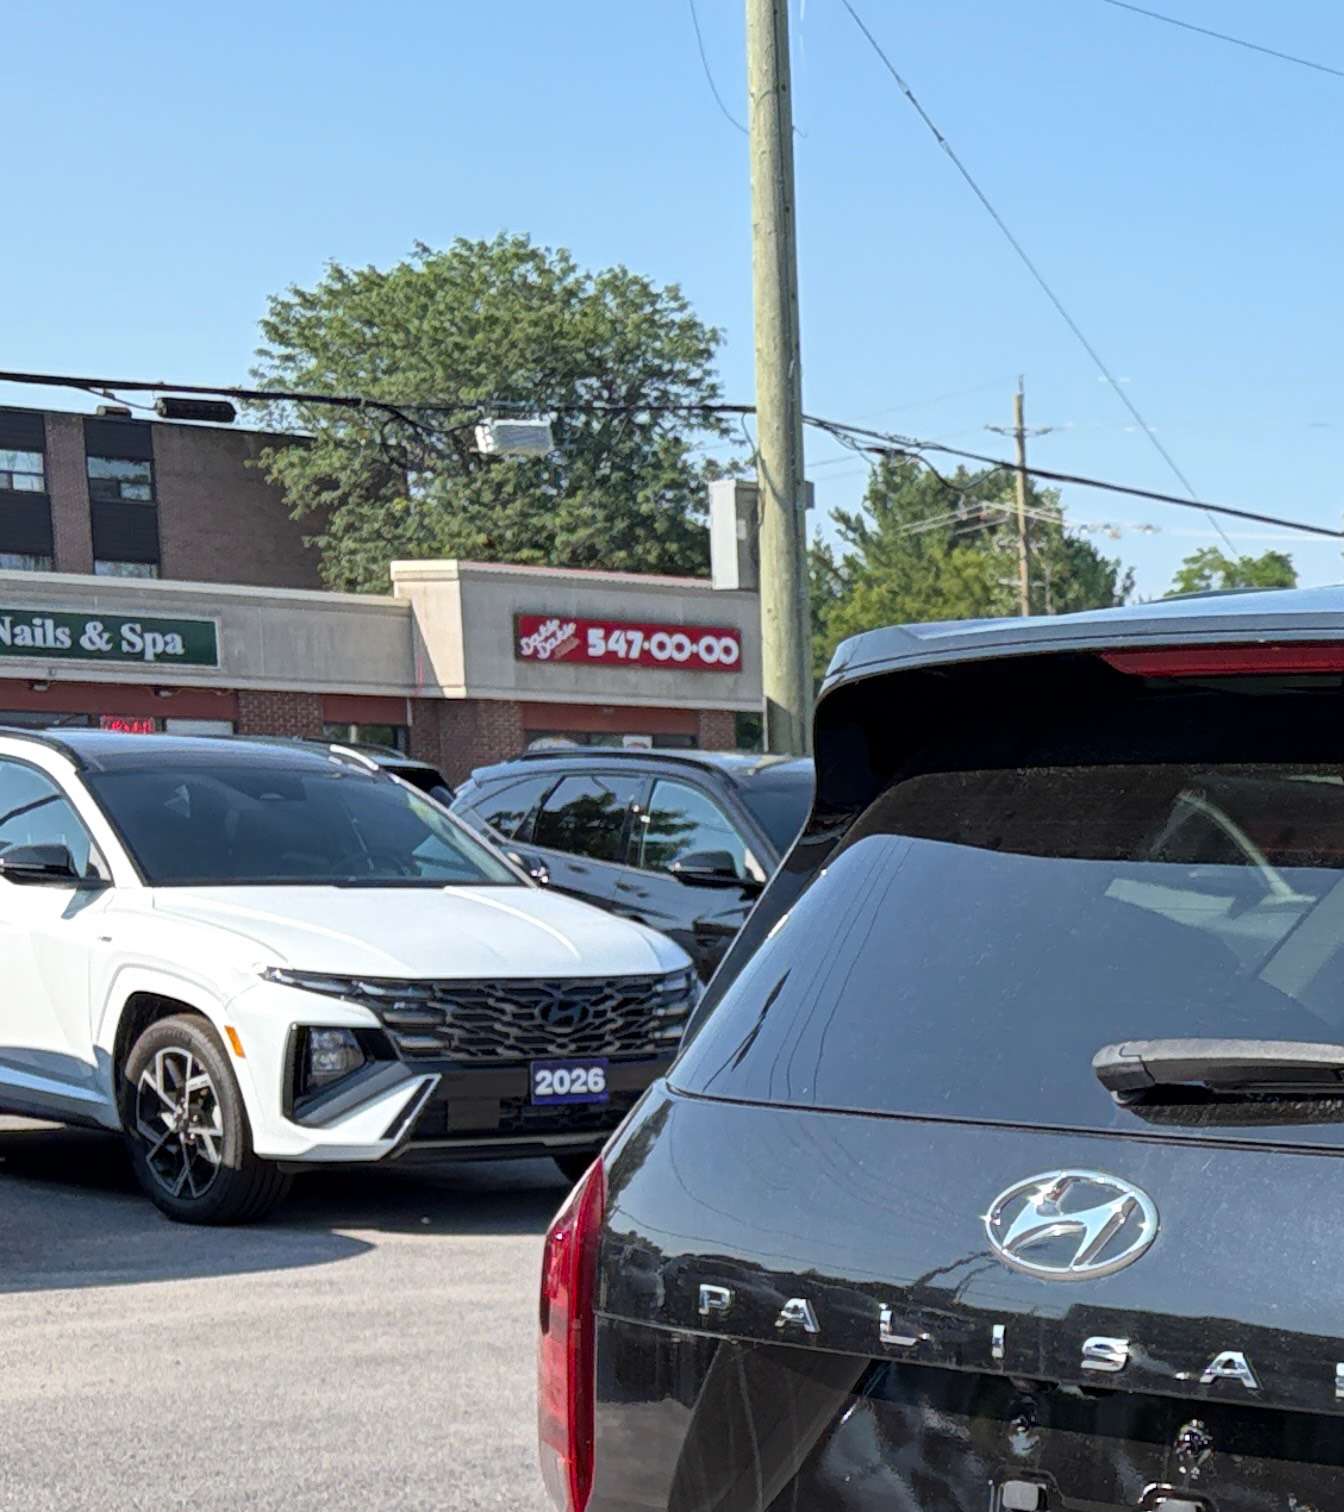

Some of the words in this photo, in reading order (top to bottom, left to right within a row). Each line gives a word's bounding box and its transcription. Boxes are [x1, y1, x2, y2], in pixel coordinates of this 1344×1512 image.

[79, 620, 113, 651] &
[120, 622, 185, 661] Spa
[535, 1066, 606, 1095] 2026
